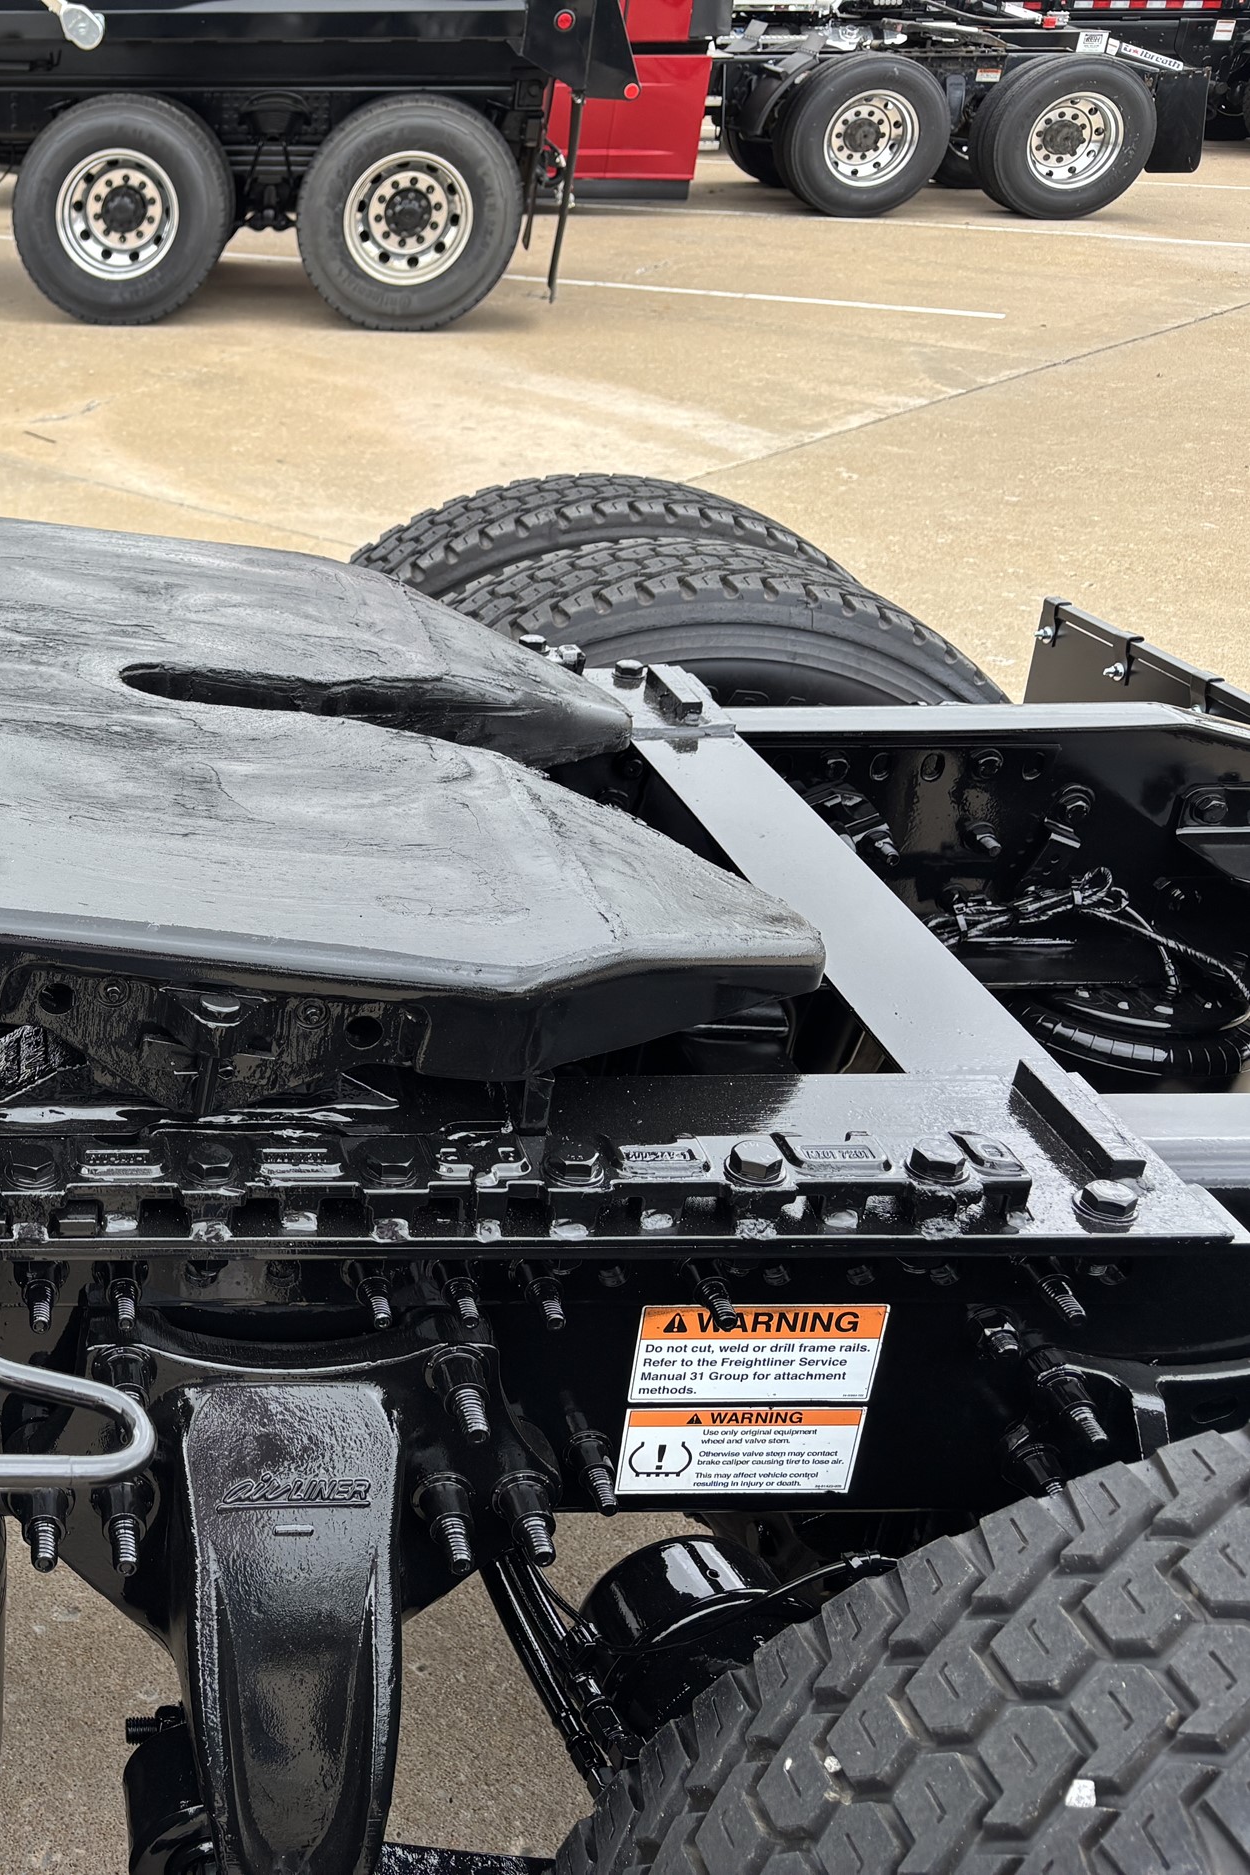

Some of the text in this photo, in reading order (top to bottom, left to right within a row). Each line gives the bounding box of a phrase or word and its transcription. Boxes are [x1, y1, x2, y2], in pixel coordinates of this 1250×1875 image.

[697, 1312, 860, 1333] WARNING
[646, 1344, 662, 1352] Do
[667, 1344, 688, 1352] not
[691, 1344, 714, 1354] cut,
[719, 1344, 749, 1352] weld
[770, 1344, 795, 1352] drill
[799, 1344, 836, 1352] frame
[840, 1344, 870, 1352] rails.
[643, 1357, 847, 1368] Refer to the Freightliner Service
[641, 1372, 846, 1382] Manual 31 Group for attachment
[638, 1386, 696, 1394] methods.
[710, 1412, 803, 1424] WARNING
